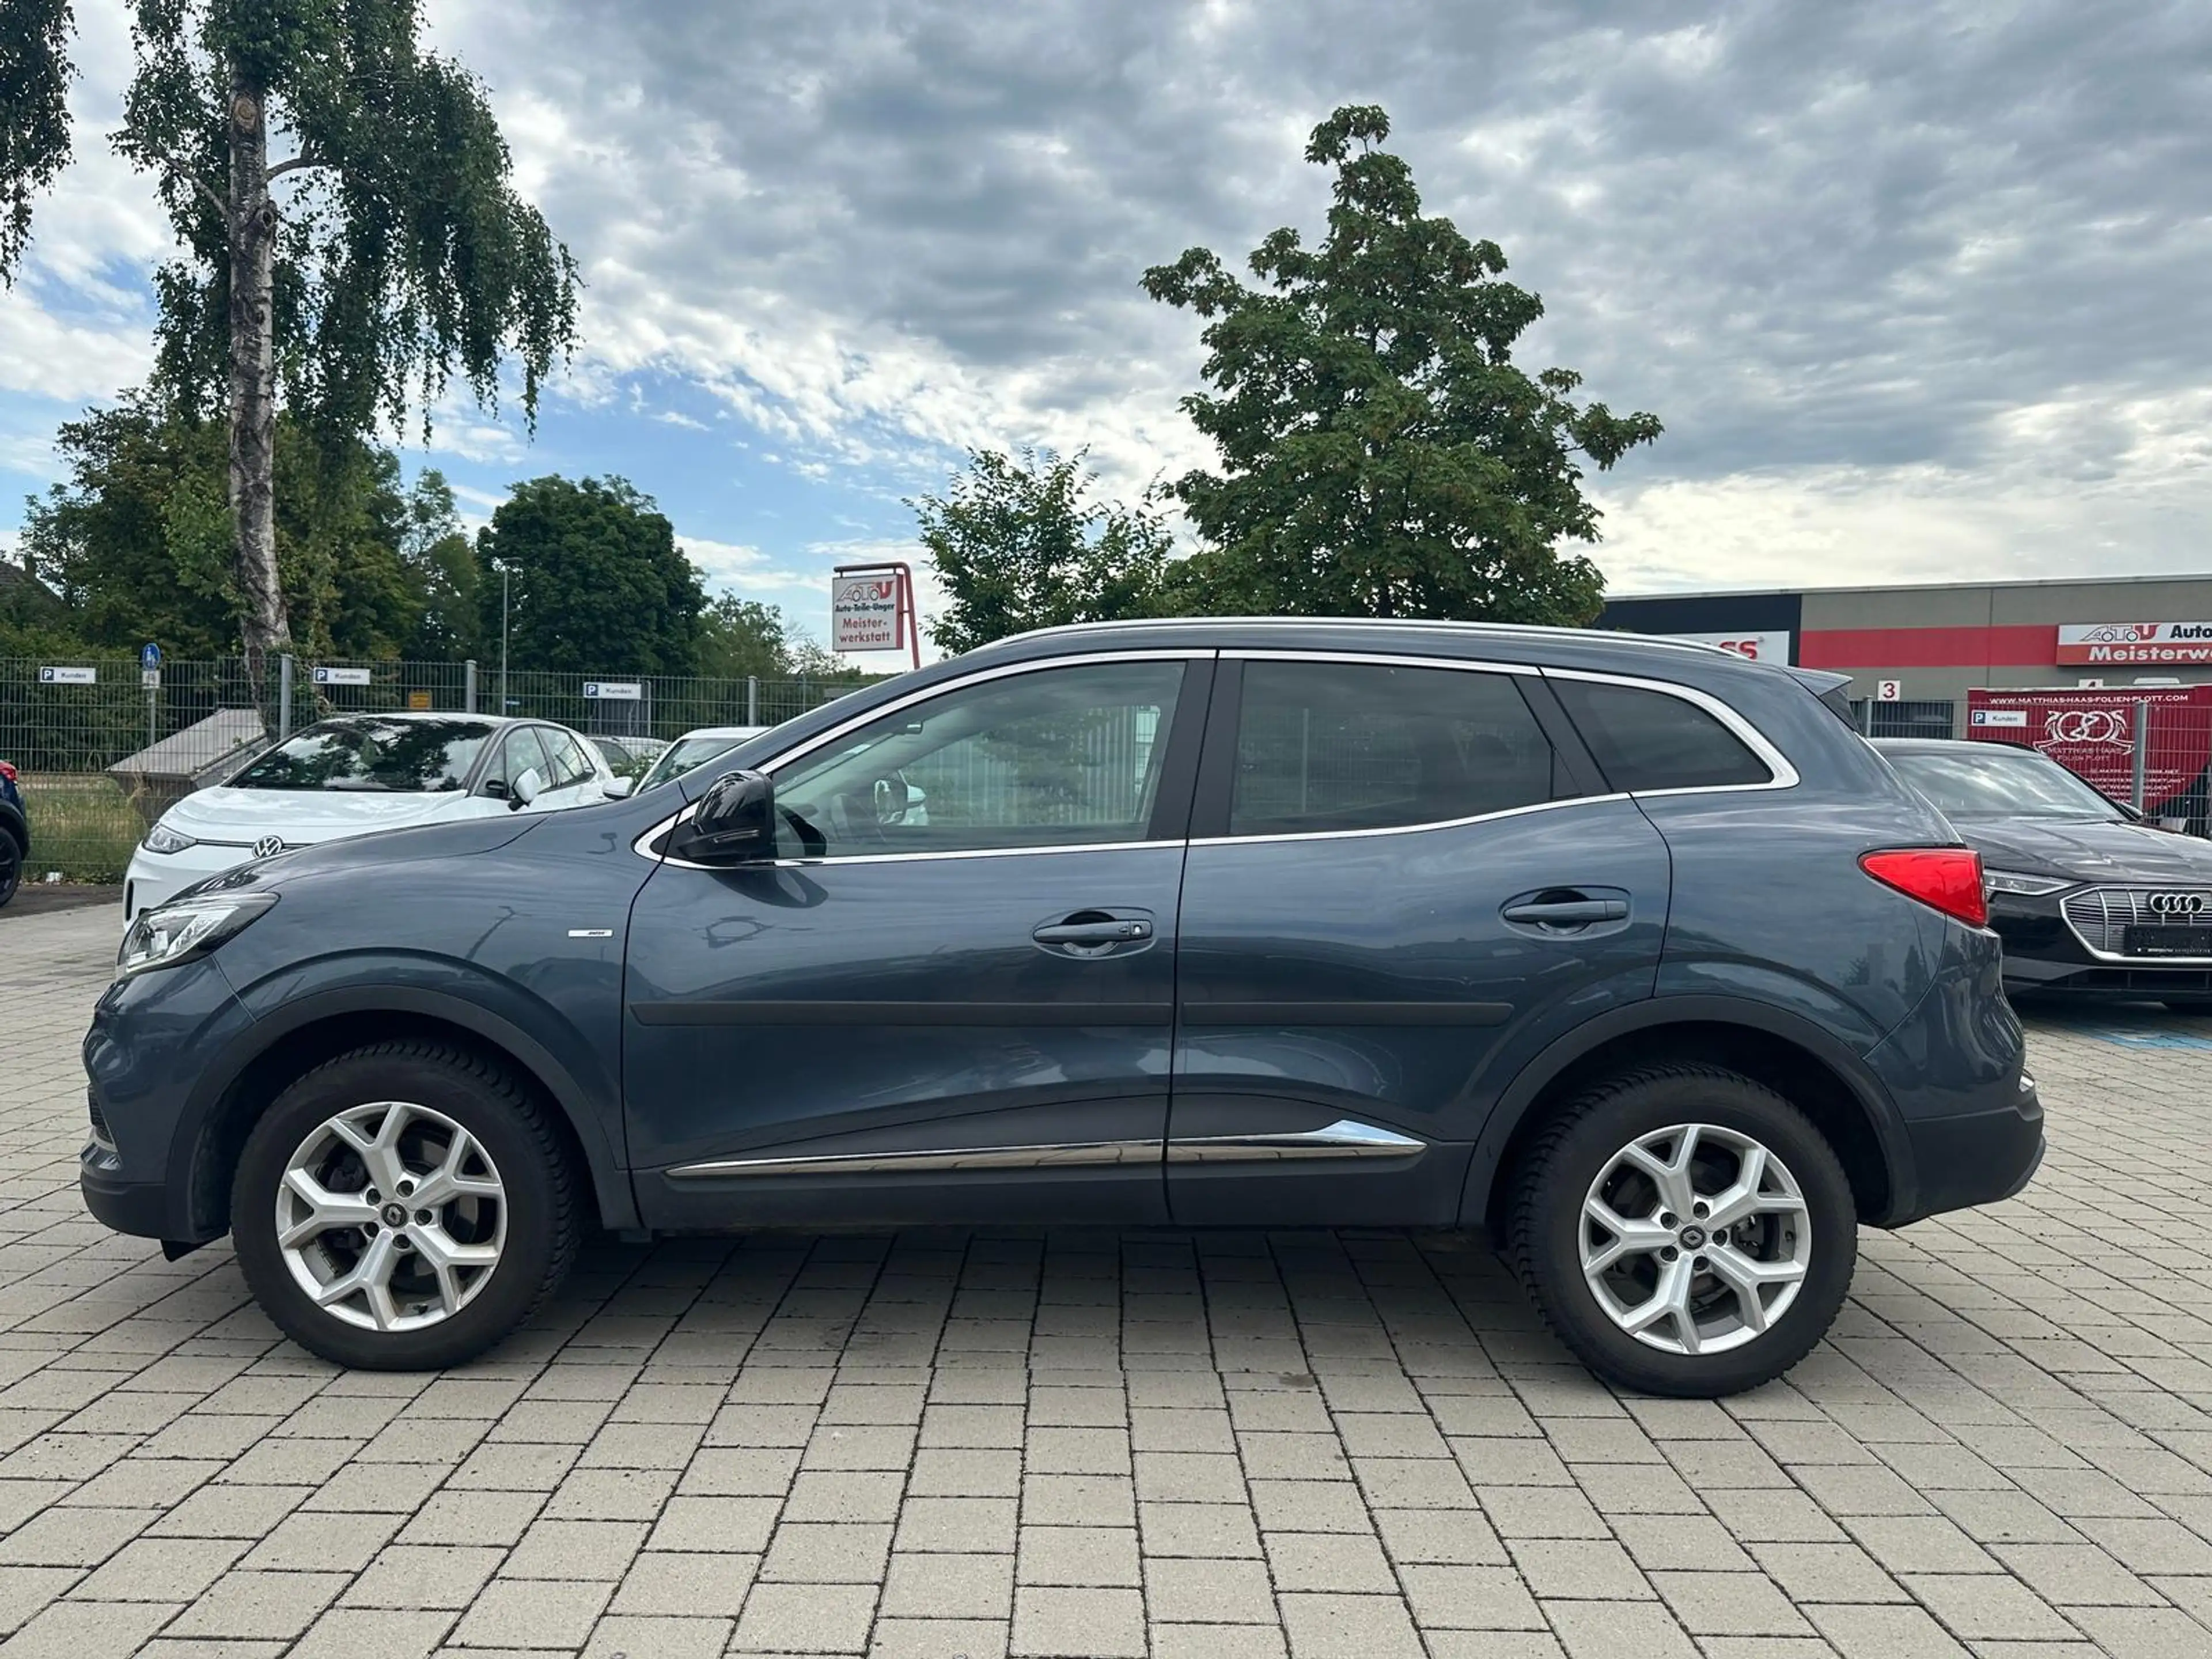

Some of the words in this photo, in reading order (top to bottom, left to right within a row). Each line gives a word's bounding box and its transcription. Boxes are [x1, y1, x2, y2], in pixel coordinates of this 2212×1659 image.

[842, 618, 887, 628] Meister-
[839, 631, 890, 643] werkstatt
[2169, 624, 2212, 638] Auto
[2089, 646, 2212, 661] Meisterw
[1883, 683, 1895, 698] 3
[1975, 714, 1983, 722] P
